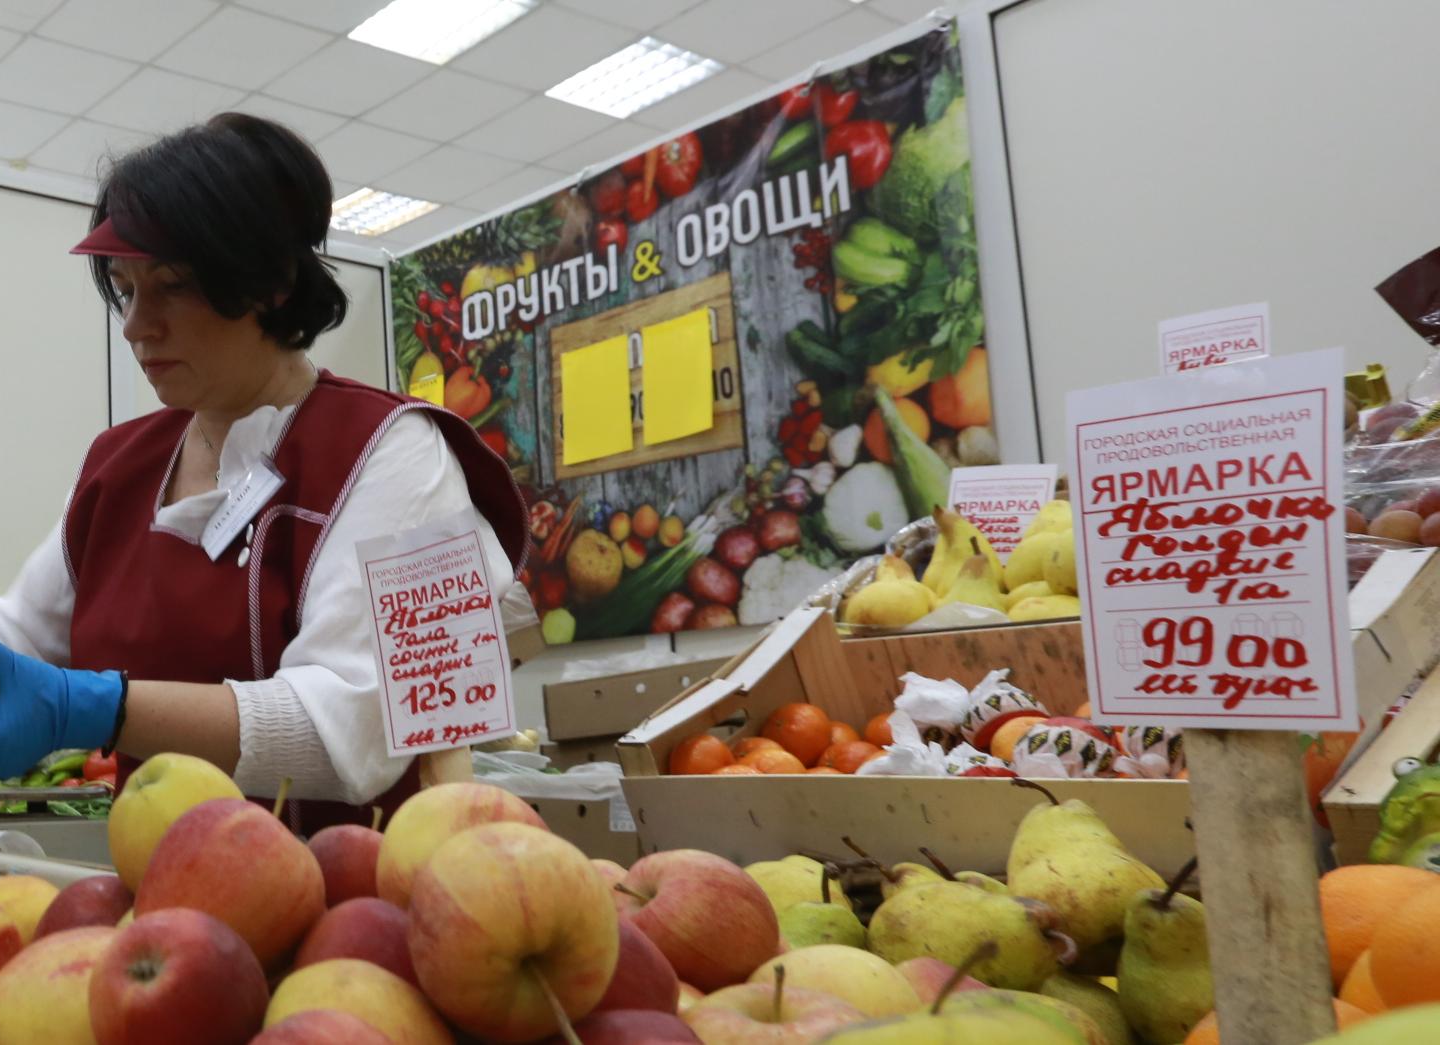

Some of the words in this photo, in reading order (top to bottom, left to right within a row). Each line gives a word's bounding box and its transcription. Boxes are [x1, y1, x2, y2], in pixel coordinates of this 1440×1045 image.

[462, 244, 618, 341] ФРУКТЫ
[631, 241, 663, 283] &
[676, 155, 851, 266] ОВОЩИ
[1169, 338, 1259, 362] ЯРМАРКА
[1084, 426, 1178, 450] ГОРОДСКАЯ
[1184, 409, 1311, 437] СОЦИАЛЬНАЯ
[1097, 428, 1295, 464] ПРОДОВОЛЬСТВЕННАЯ
[1091, 452, 1312, 504] ЯРМАРКА
[959, 500, 1041, 512] ЯРМАРКА
[379, 570, 483, 613] ЯРМАРКА
[1142, 616, 1214, 668] 99
[1226, 635, 1308, 667] 00
[400, 676, 456, 715] 125
[465, 683, 496, 705] 00
